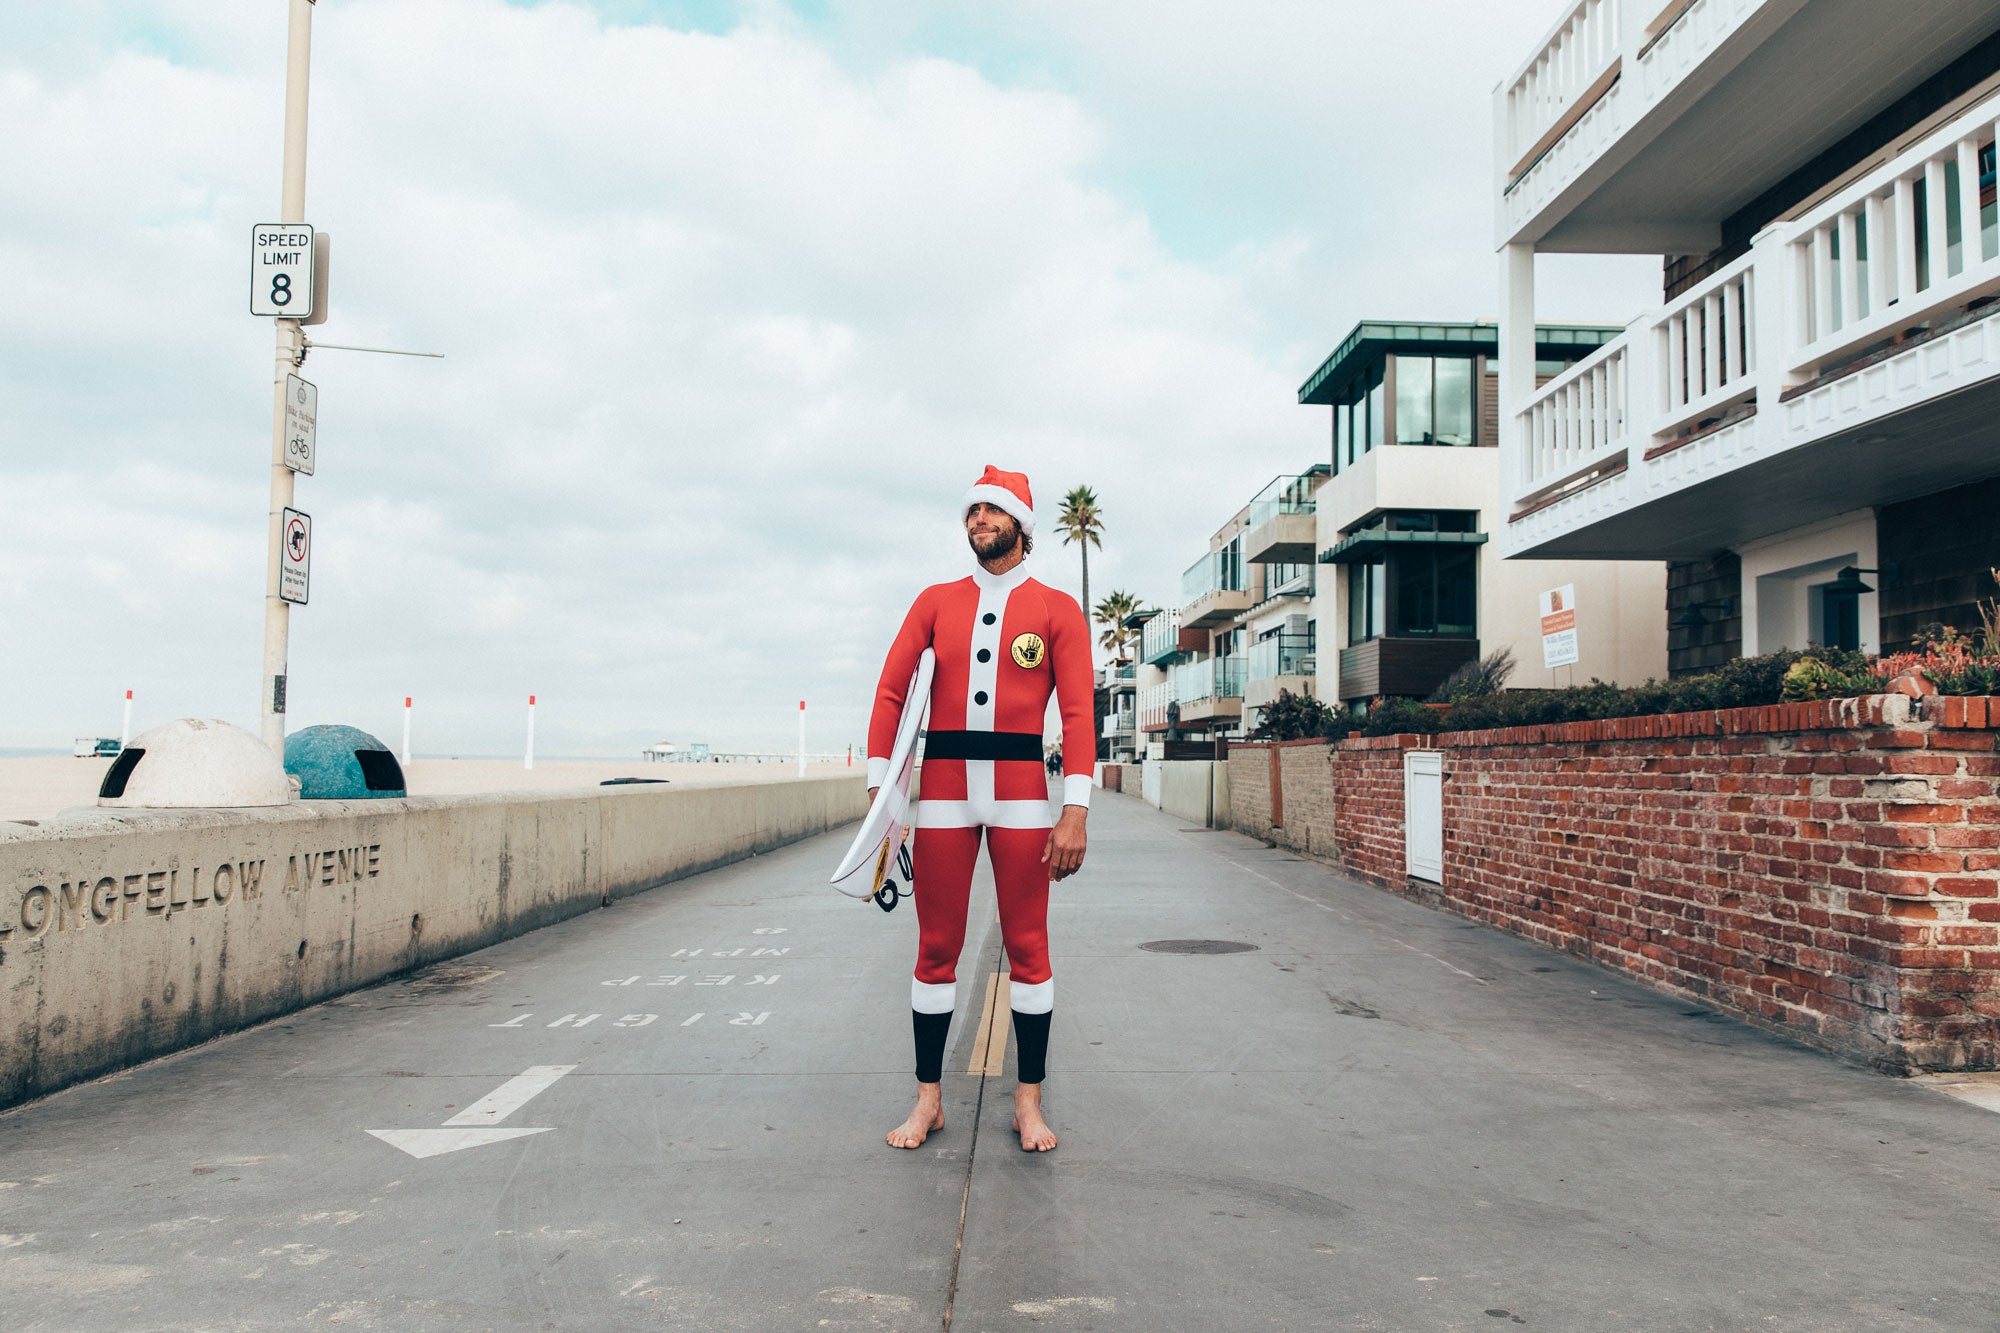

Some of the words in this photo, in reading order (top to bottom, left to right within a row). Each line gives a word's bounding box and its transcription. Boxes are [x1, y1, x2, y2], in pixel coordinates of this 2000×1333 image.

[258, 234, 308, 247] SPEED
[263, 252, 301, 265] LIMIT
[270, 273, 292, 307] 8
[288, 405, 298, 417] Bike
[284, 566, 294, 574] Please
[282, 843, 382, 895] AVENUE
[670, 947, 791, 957] MPH
[600, 974, 783, 986] KEEP
[487, 1011, 773, 1028] RIGHT
